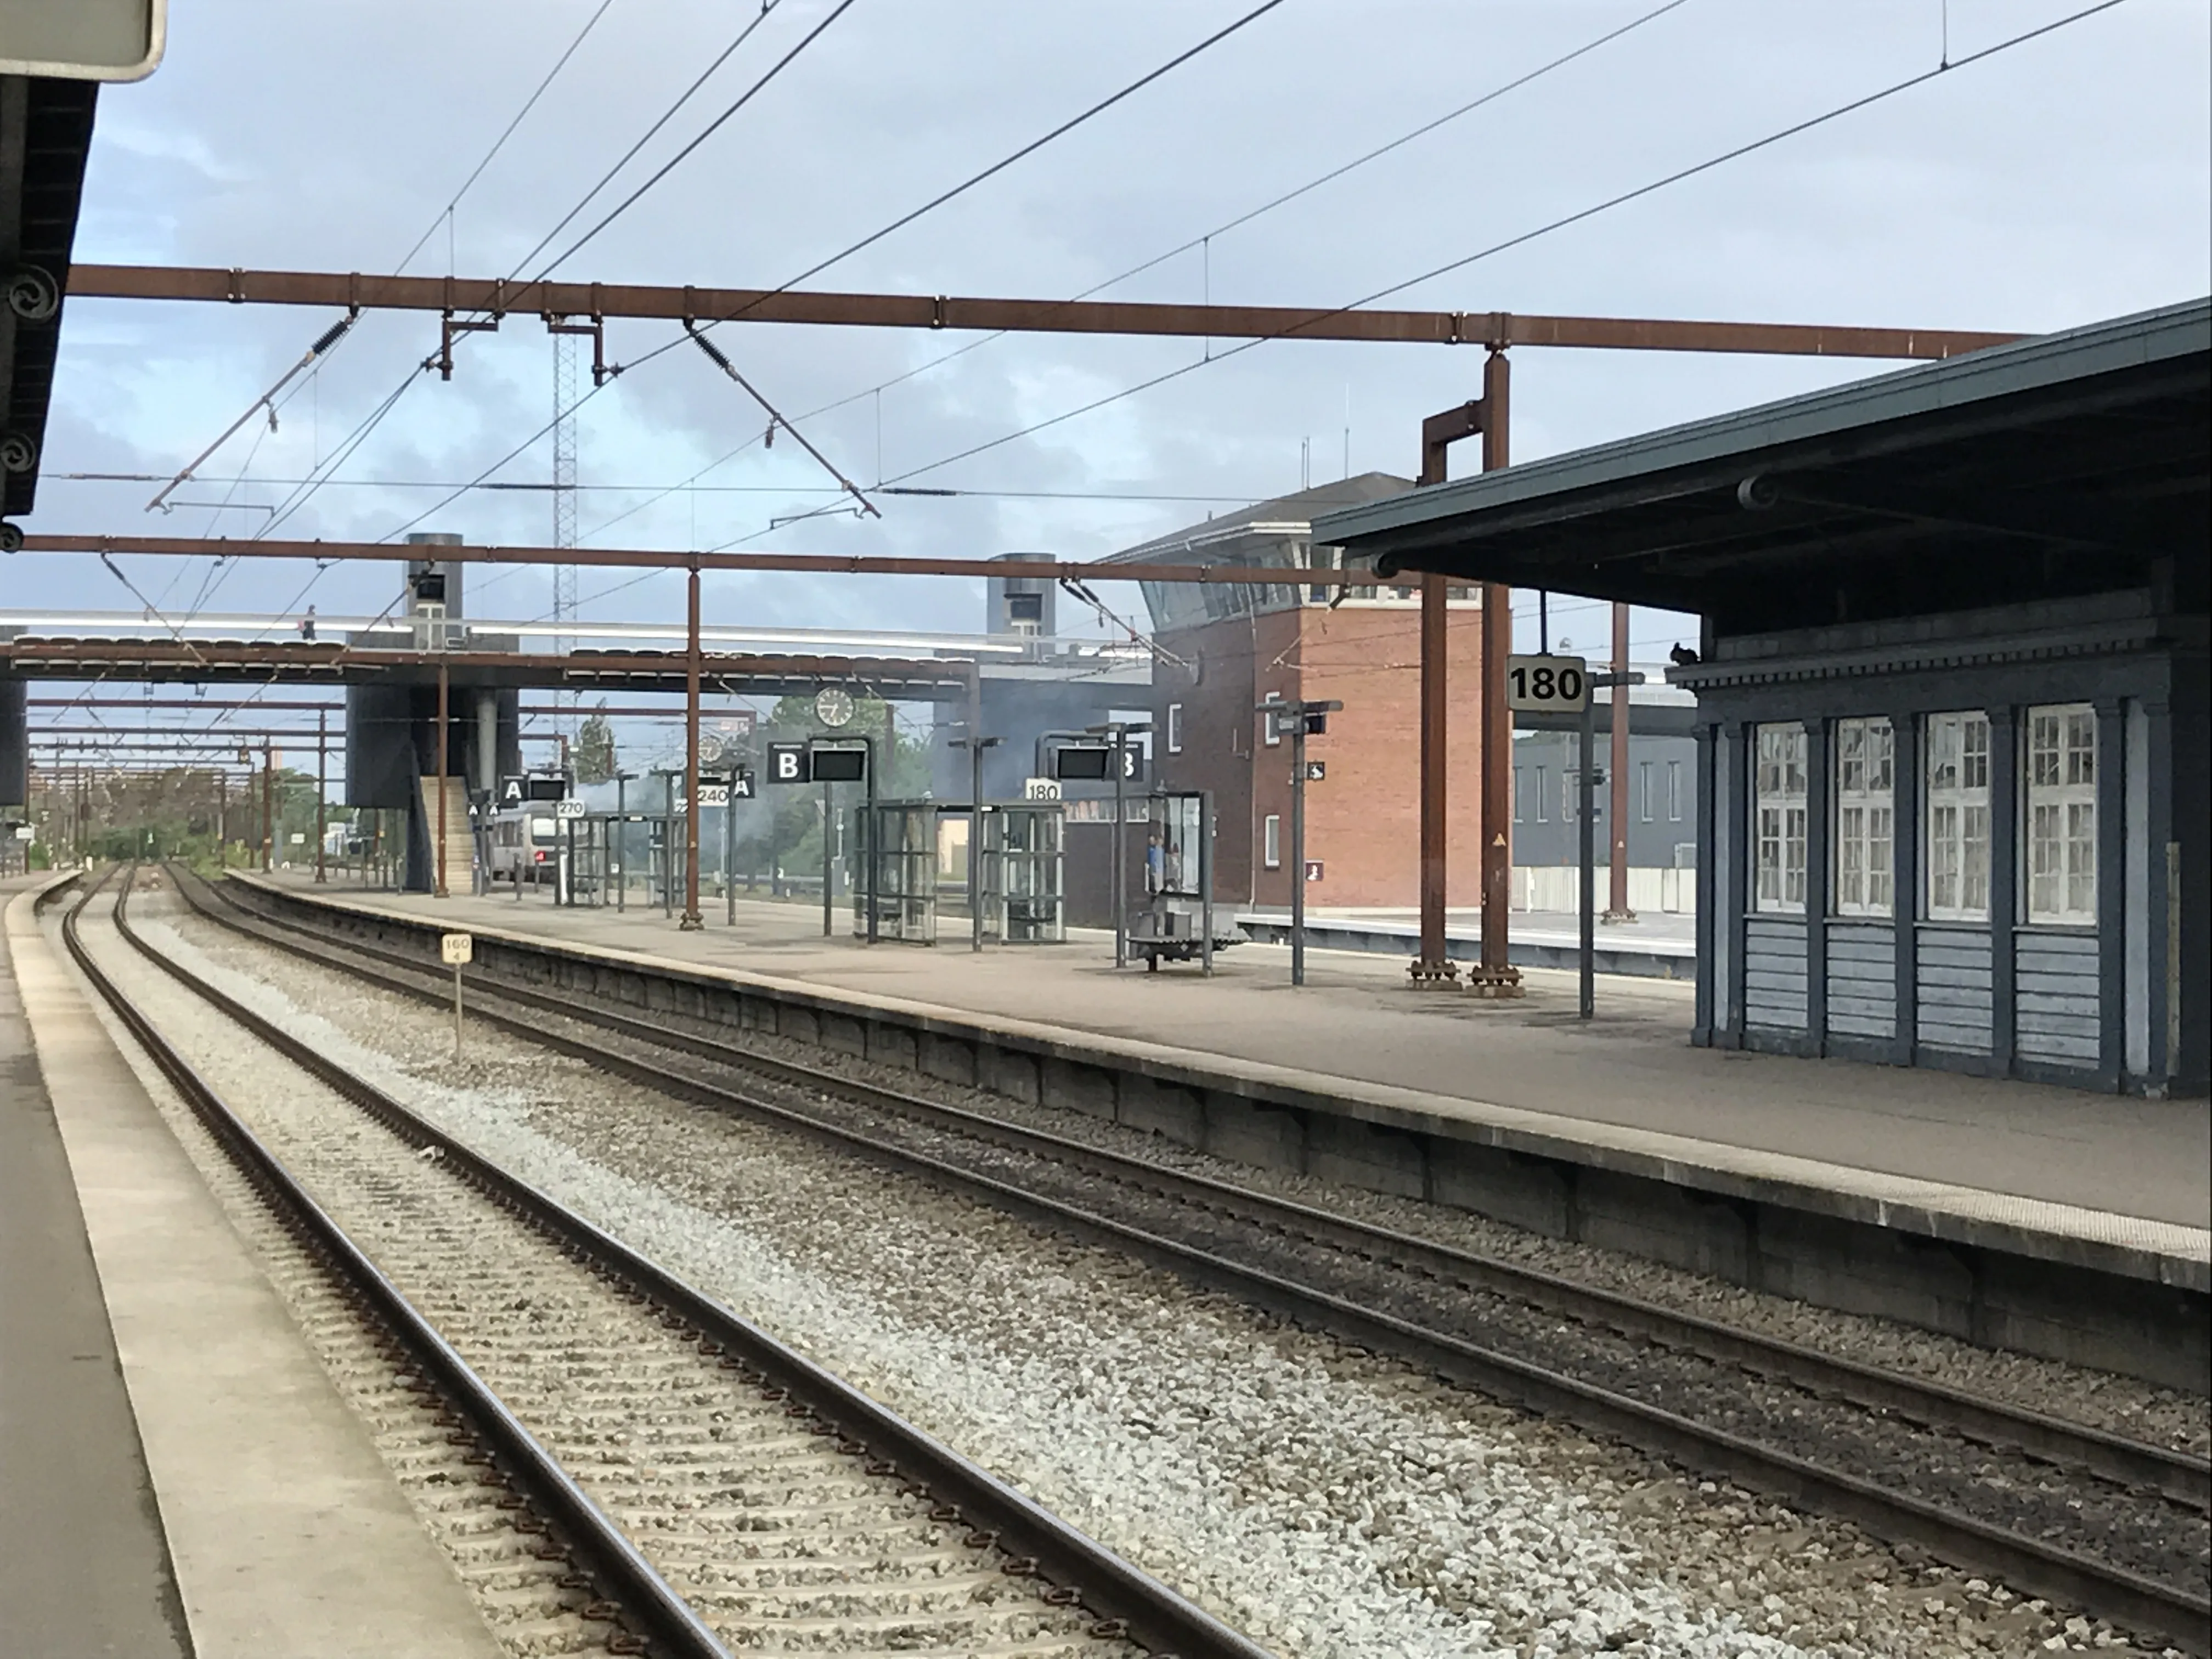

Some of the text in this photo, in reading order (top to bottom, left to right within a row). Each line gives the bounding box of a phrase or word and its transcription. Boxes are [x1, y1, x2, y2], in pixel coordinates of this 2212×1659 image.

[1510, 667, 1582, 700] 180
[780, 753, 799, 778] B
[505, 781, 522, 799] A
[734, 780, 749, 795] A
[1030, 785, 1058, 799] 180
[697, 789, 728, 802] 240
[469, 805, 478, 816] A
[489, 805, 498, 816] A
[558, 802, 583, 814] 270
